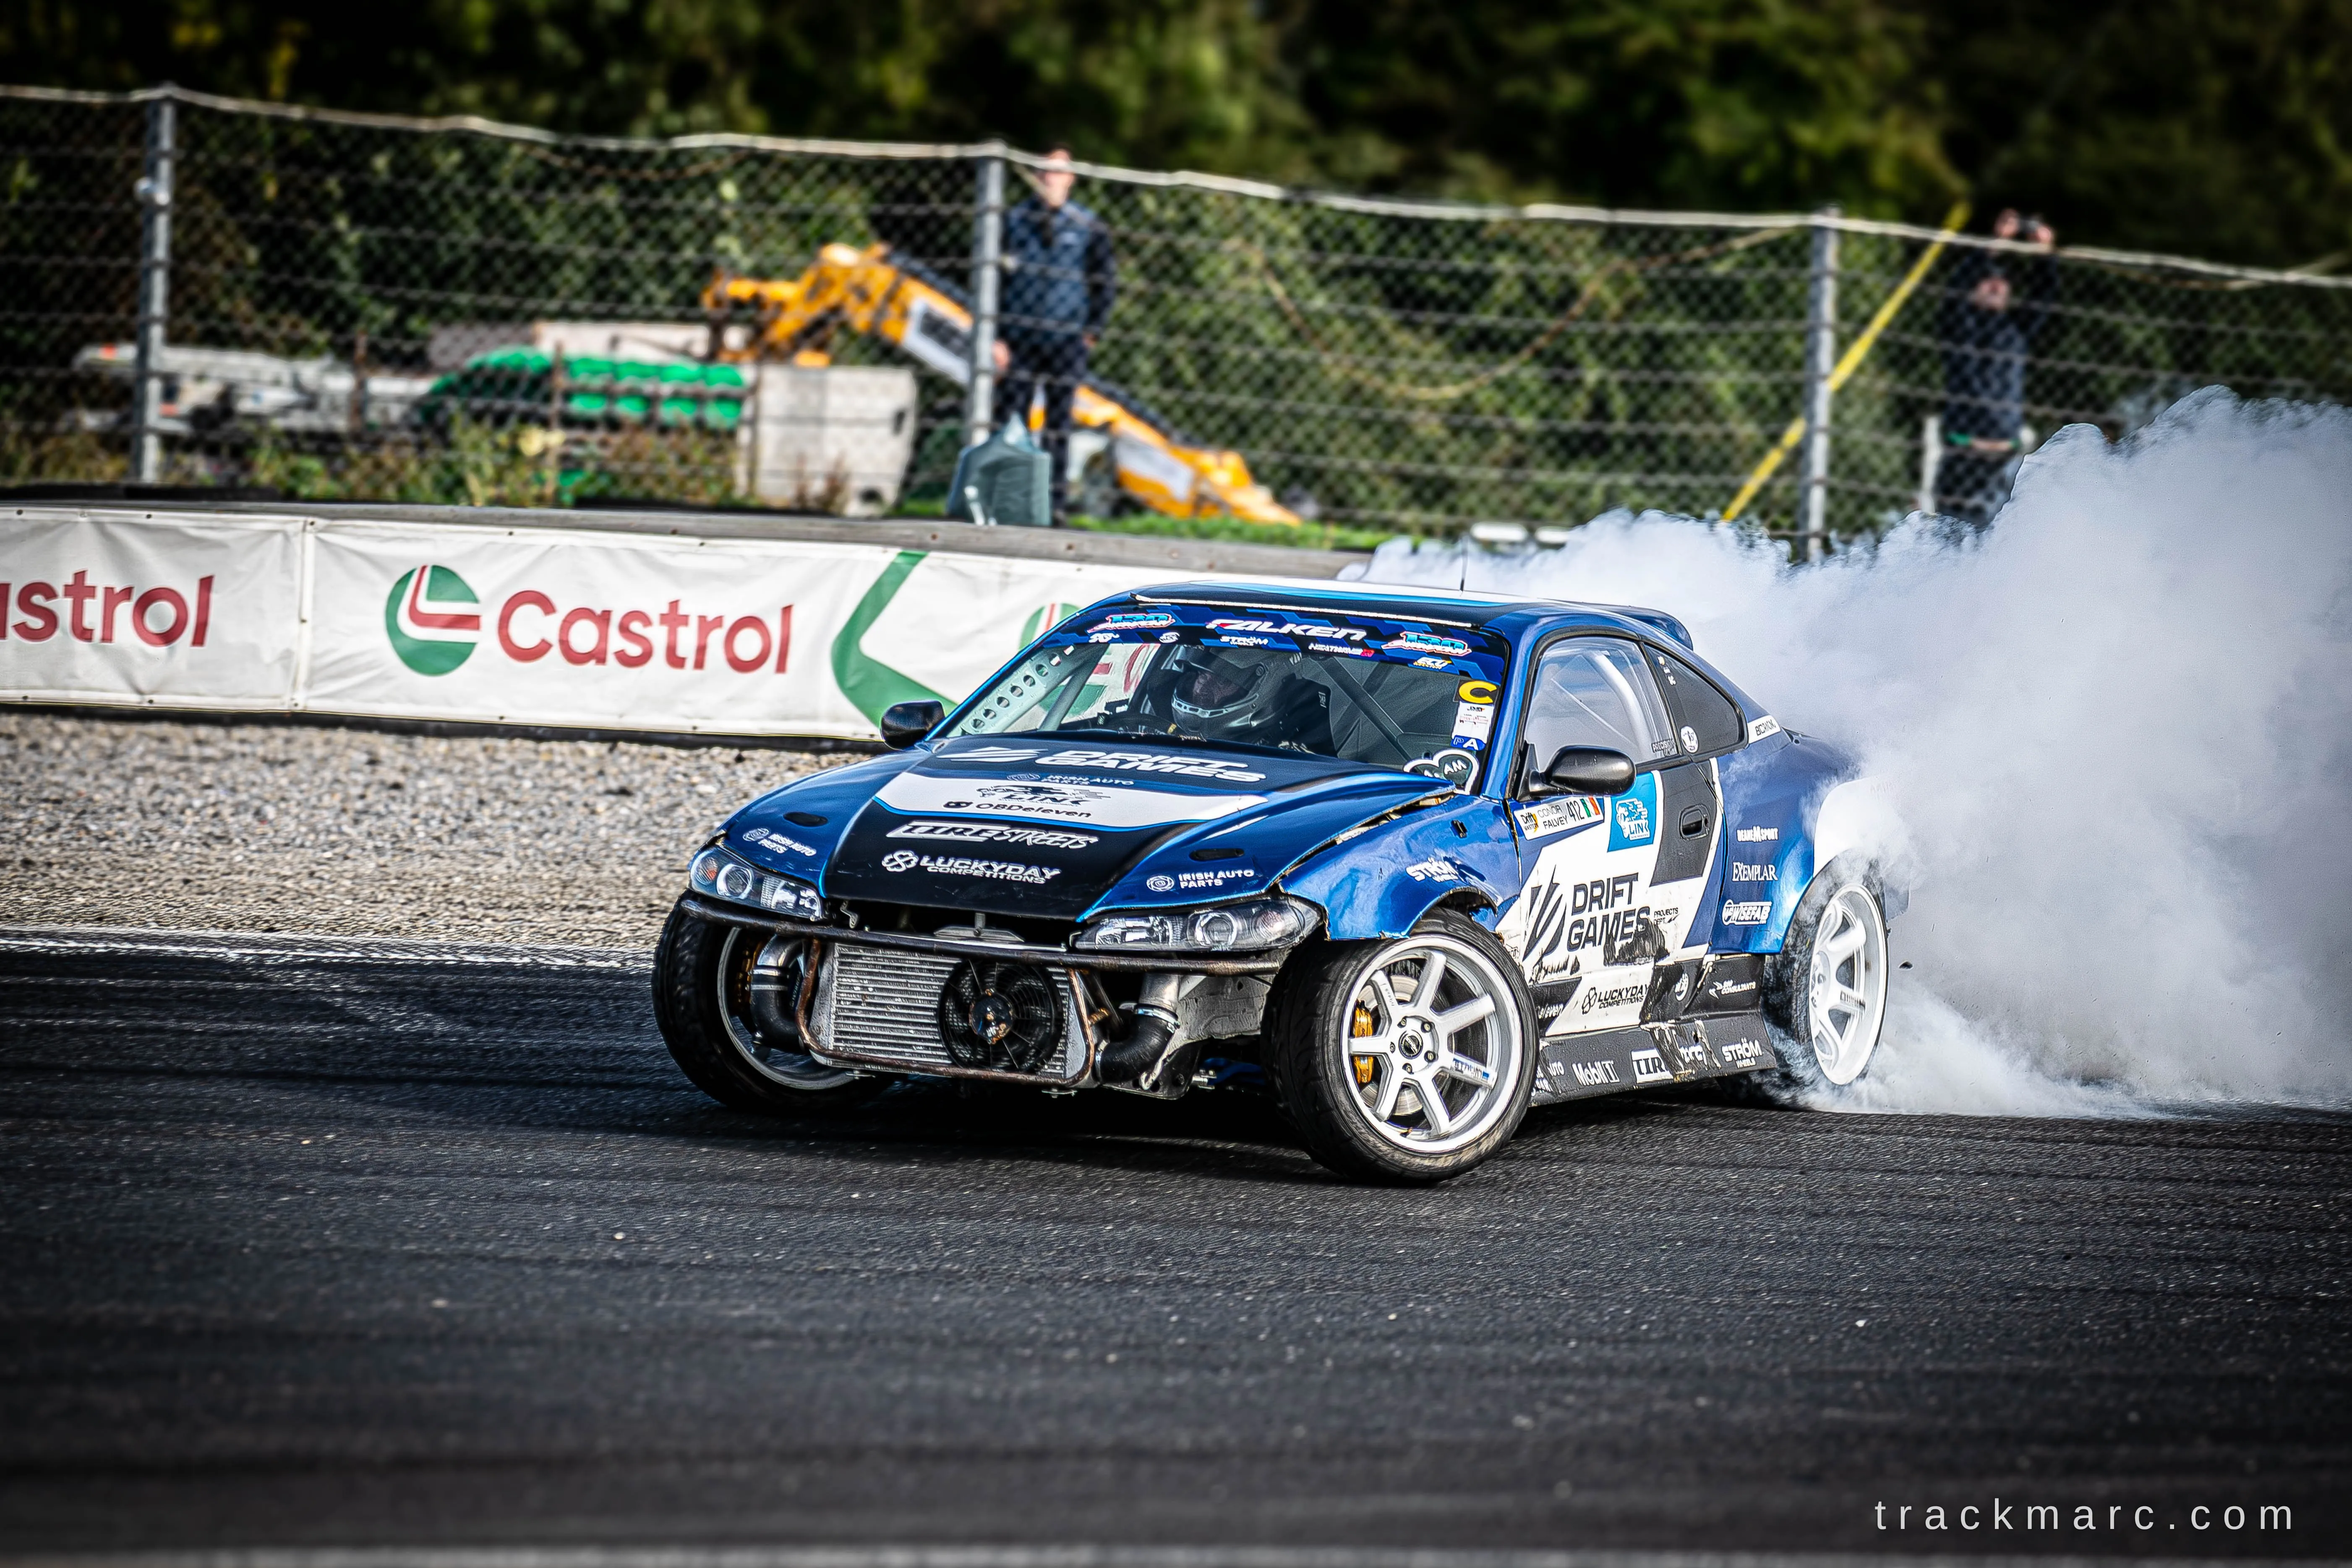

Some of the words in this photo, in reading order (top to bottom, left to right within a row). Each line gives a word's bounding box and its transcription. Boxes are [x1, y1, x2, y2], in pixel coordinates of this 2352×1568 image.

[0, 569, 214, 647] strol
[497, 590, 794, 674] Castrol
[1459, 680, 1497, 704] C
[1035, 757, 1266, 782] GAMES
[1052, 750, 1248, 769] DRIFT
[976, 803, 1092, 818] OBDeleven
[1537, 804, 1563, 818] CONOR
[1566, 800, 1585, 822] 412
[1543, 815, 1568, 830] FALVEY
[920, 856, 1061, 880] LUCKYDAY
[927, 866, 1047, 884] COMPETITIONS
[1178, 871, 1214, 882] IRISH
[1217, 869, 1255, 879] AUTO
[1732, 862, 1778, 882] EXEMPLAR
[1180, 879, 1224, 889] PARTS
[1571, 872, 1639, 916] DRIFT
[1567, 906, 1650, 952] GAMES
[1721, 1037, 1762, 1062] STRÖM
[1632, 1056, 1665, 1075] TIR
